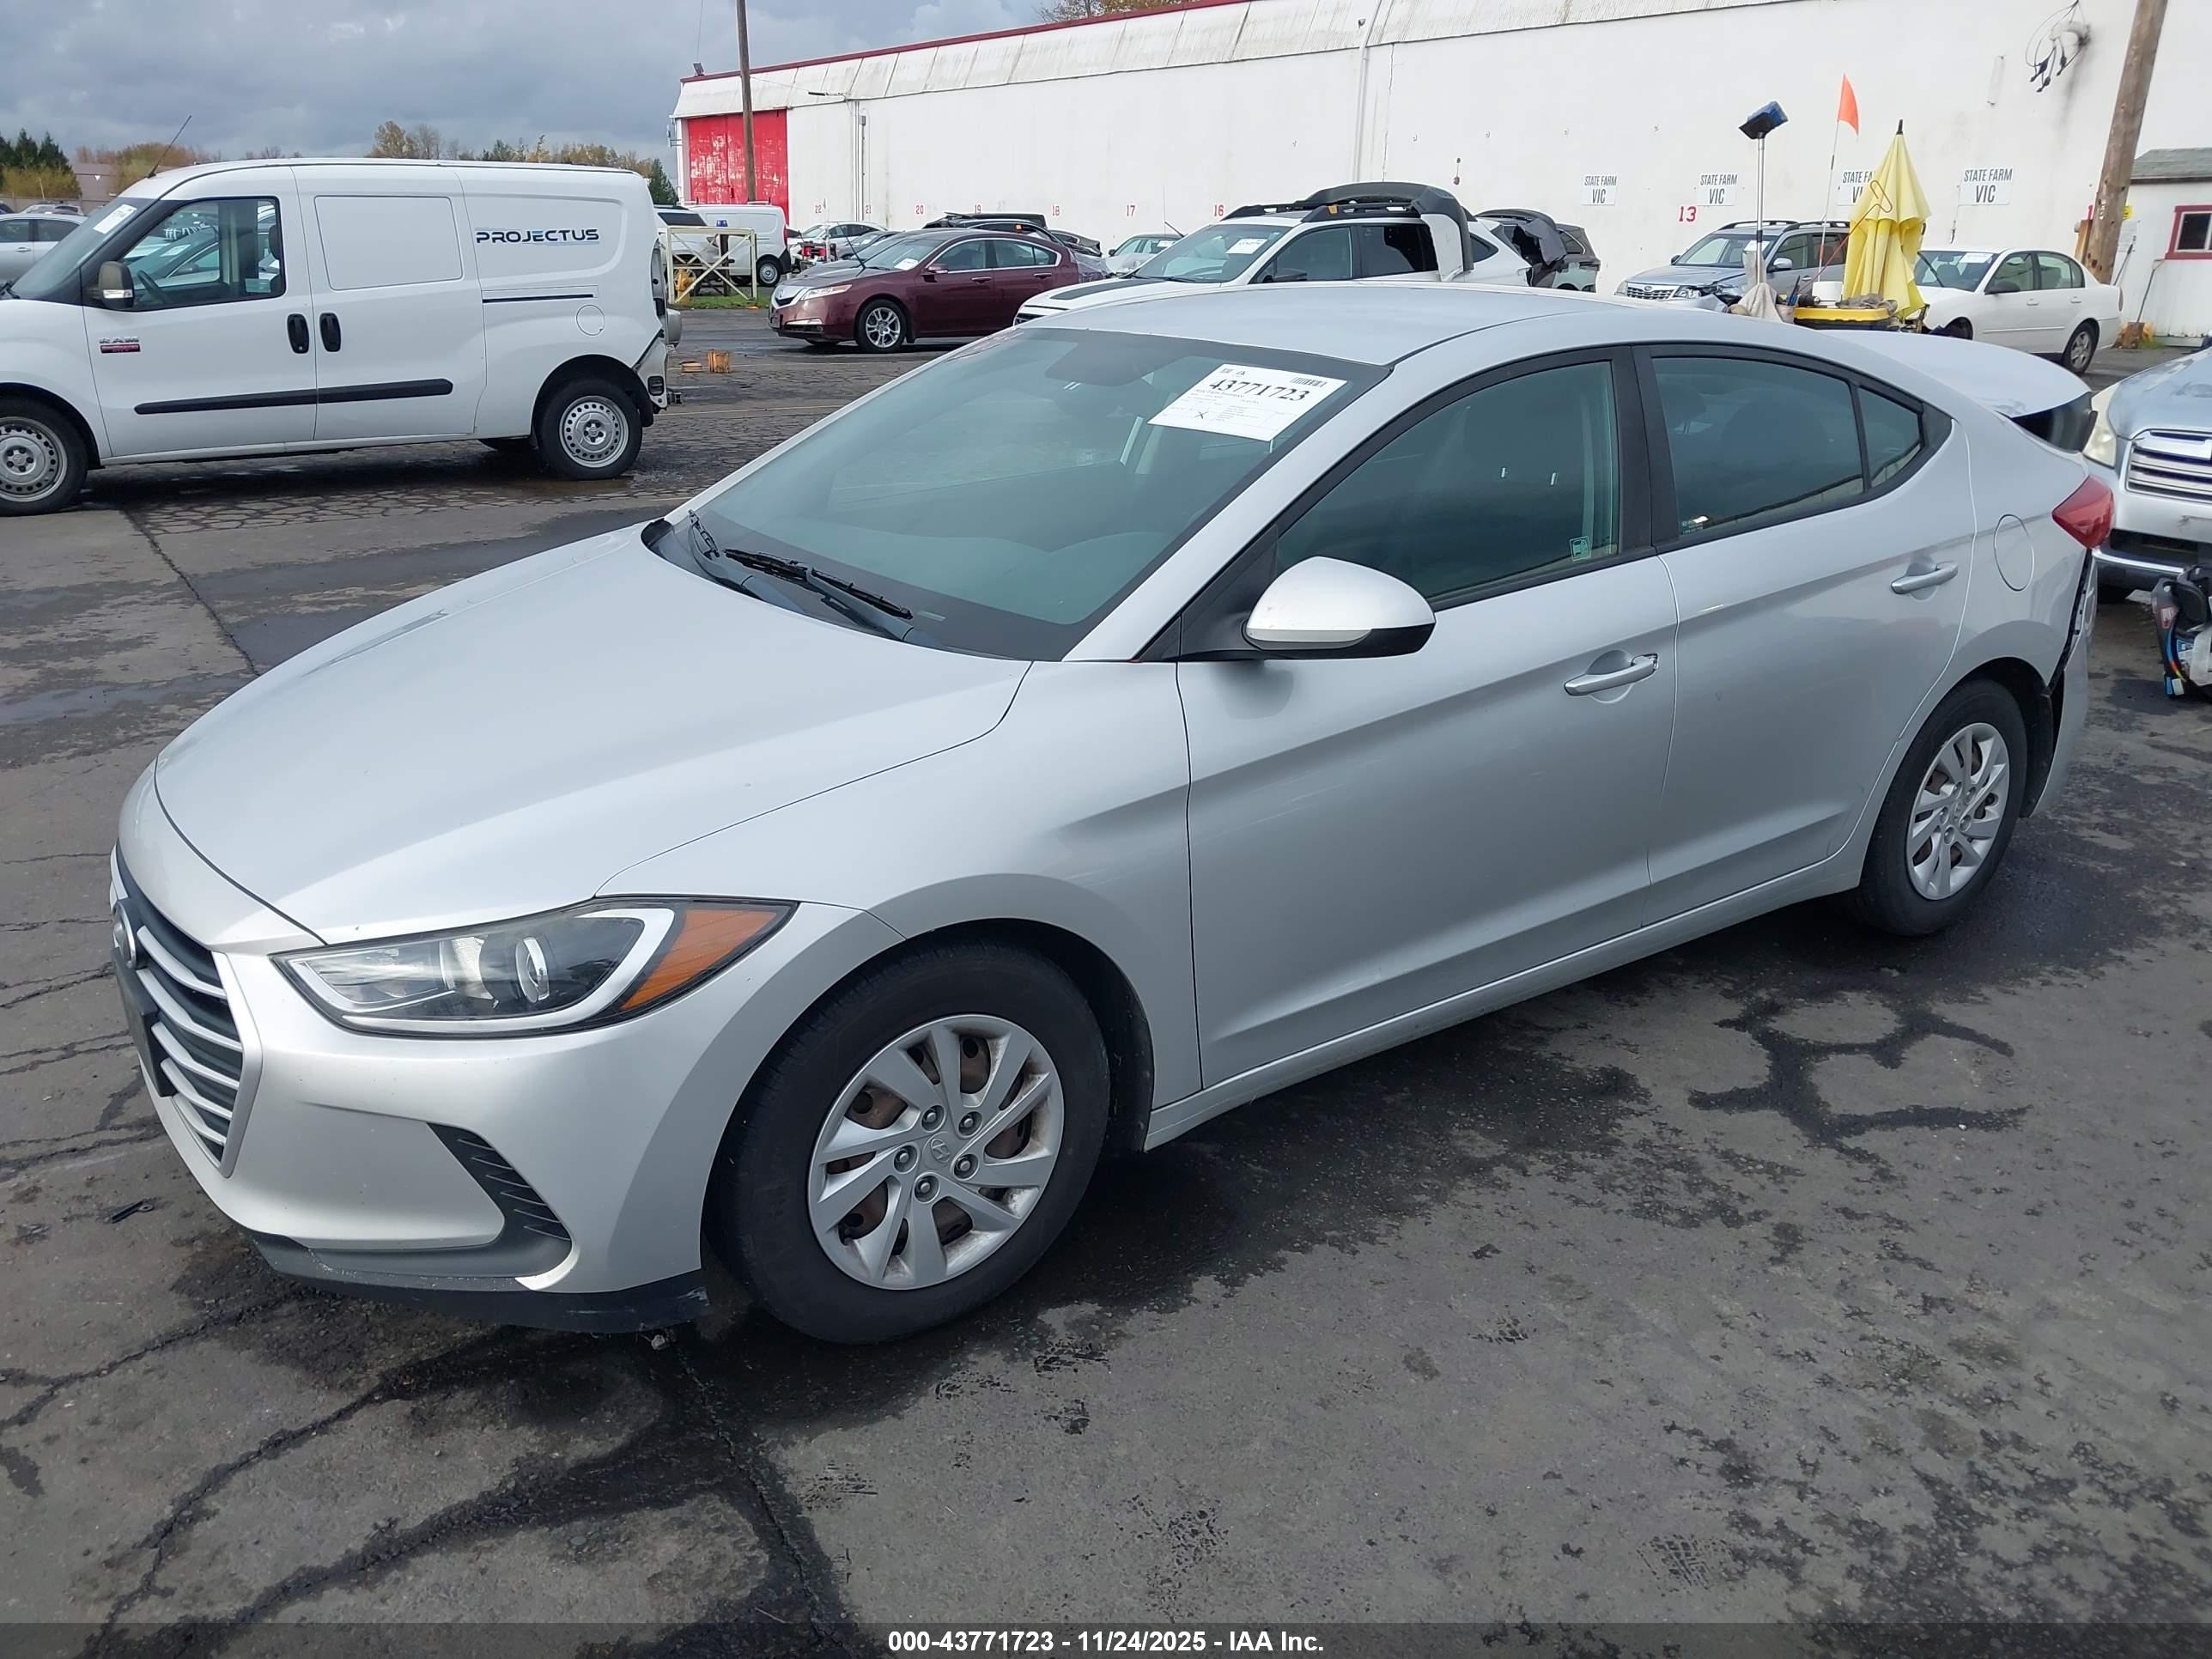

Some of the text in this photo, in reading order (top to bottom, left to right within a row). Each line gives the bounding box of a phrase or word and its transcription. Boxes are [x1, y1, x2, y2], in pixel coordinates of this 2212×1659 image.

[1700, 174, 1737, 185] STATE FARM
[1843, 172, 1862, 183] STATE
[1964, 168, 2012, 181] STATE FARM
[1584, 176, 1617, 185] STATE FARM
[1592, 189, 1606, 204] VIC
[1709, 188, 1724, 204] VIC
[1852, 186, 1863, 203] VI
[1976, 185, 1996, 203] VIC
[866, 205, 872, 214] 21
[916, 204, 924, 214] 20
[975, 204, 981, 213] 19
[1052, 205, 1060, 216] 18
[1127, 205, 1135, 216] 17
[1214, 205, 1224, 216] 16
[1679, 206, 1697, 222] 13
[476, 229, 599, 244] PROJECTUS
[1209, 379, 1310, 401] 43771723
